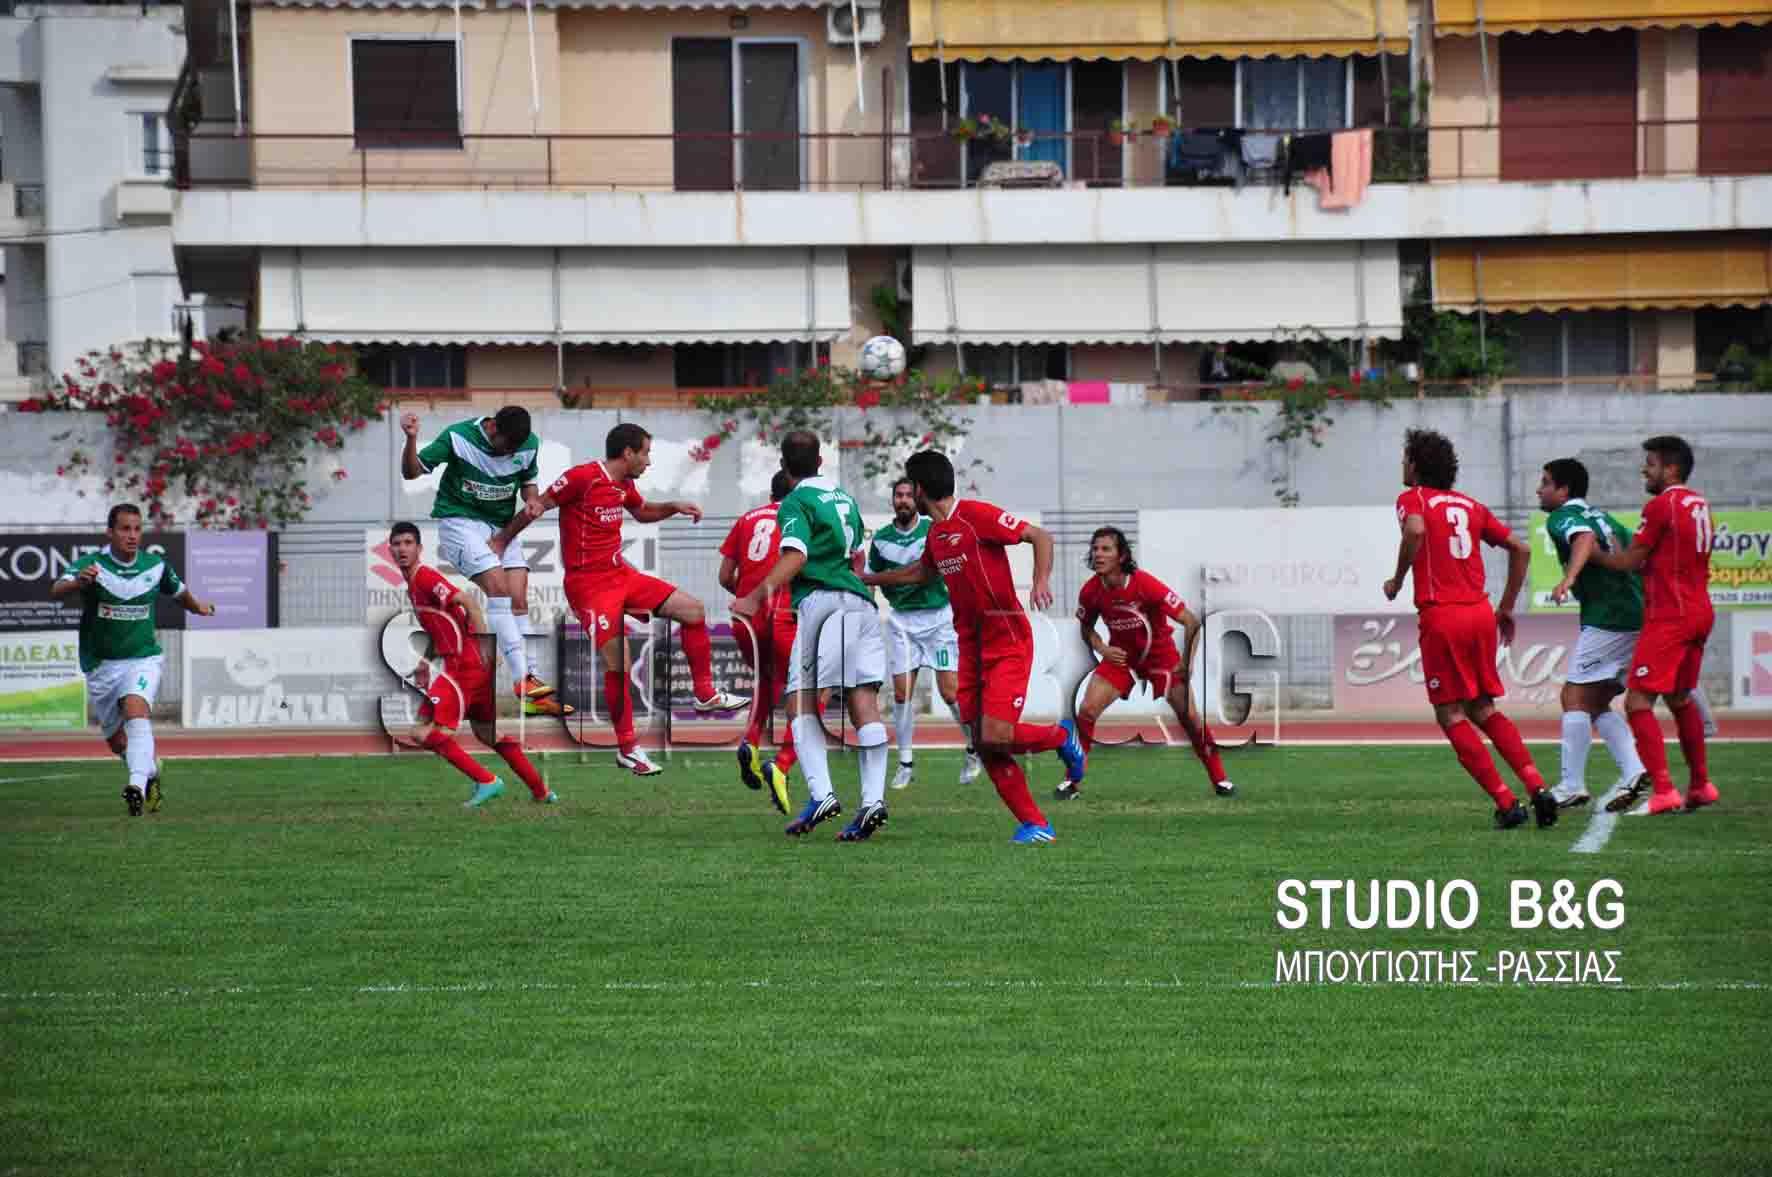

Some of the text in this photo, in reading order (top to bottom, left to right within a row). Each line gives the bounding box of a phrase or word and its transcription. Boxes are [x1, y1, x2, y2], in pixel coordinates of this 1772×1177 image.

[747, 518, 777, 561] 8
[1446, 506, 1472, 559] 3
[1690, 503, 1712, 552] 11
[936, 649, 949, 667] 10
[137, 674, 149, 690] 4
